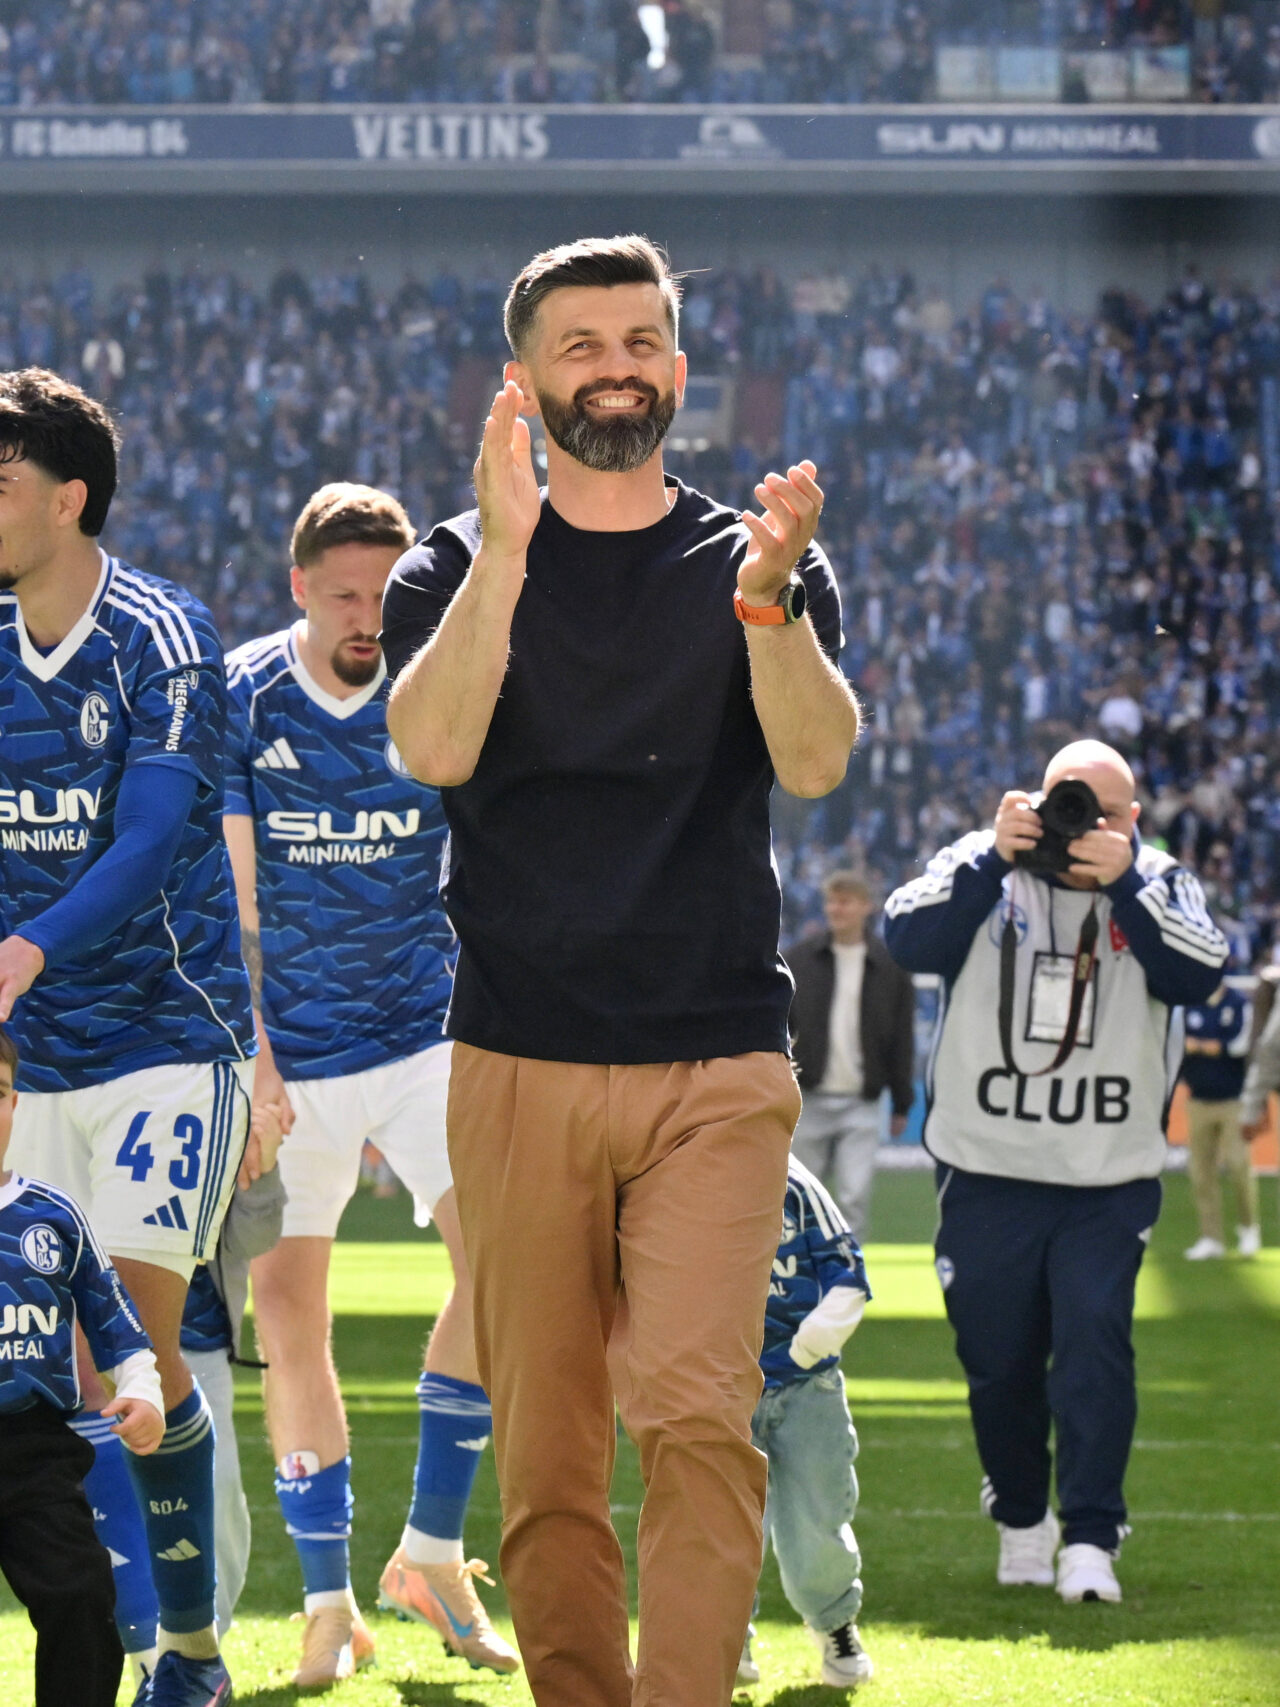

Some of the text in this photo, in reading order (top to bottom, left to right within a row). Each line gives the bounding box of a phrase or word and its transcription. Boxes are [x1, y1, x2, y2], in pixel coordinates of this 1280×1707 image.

[352, 115, 550, 159] VELTINS
[165, 678, 188, 752] HEGMANNS
[266, 808, 420, 841] SUN
[288, 842, 396, 865] MINIMEAL
[977, 1067, 1132, 1125] CLUB
[115, 1111, 205, 1190] 43
[149, 1498, 189, 1515] S04
